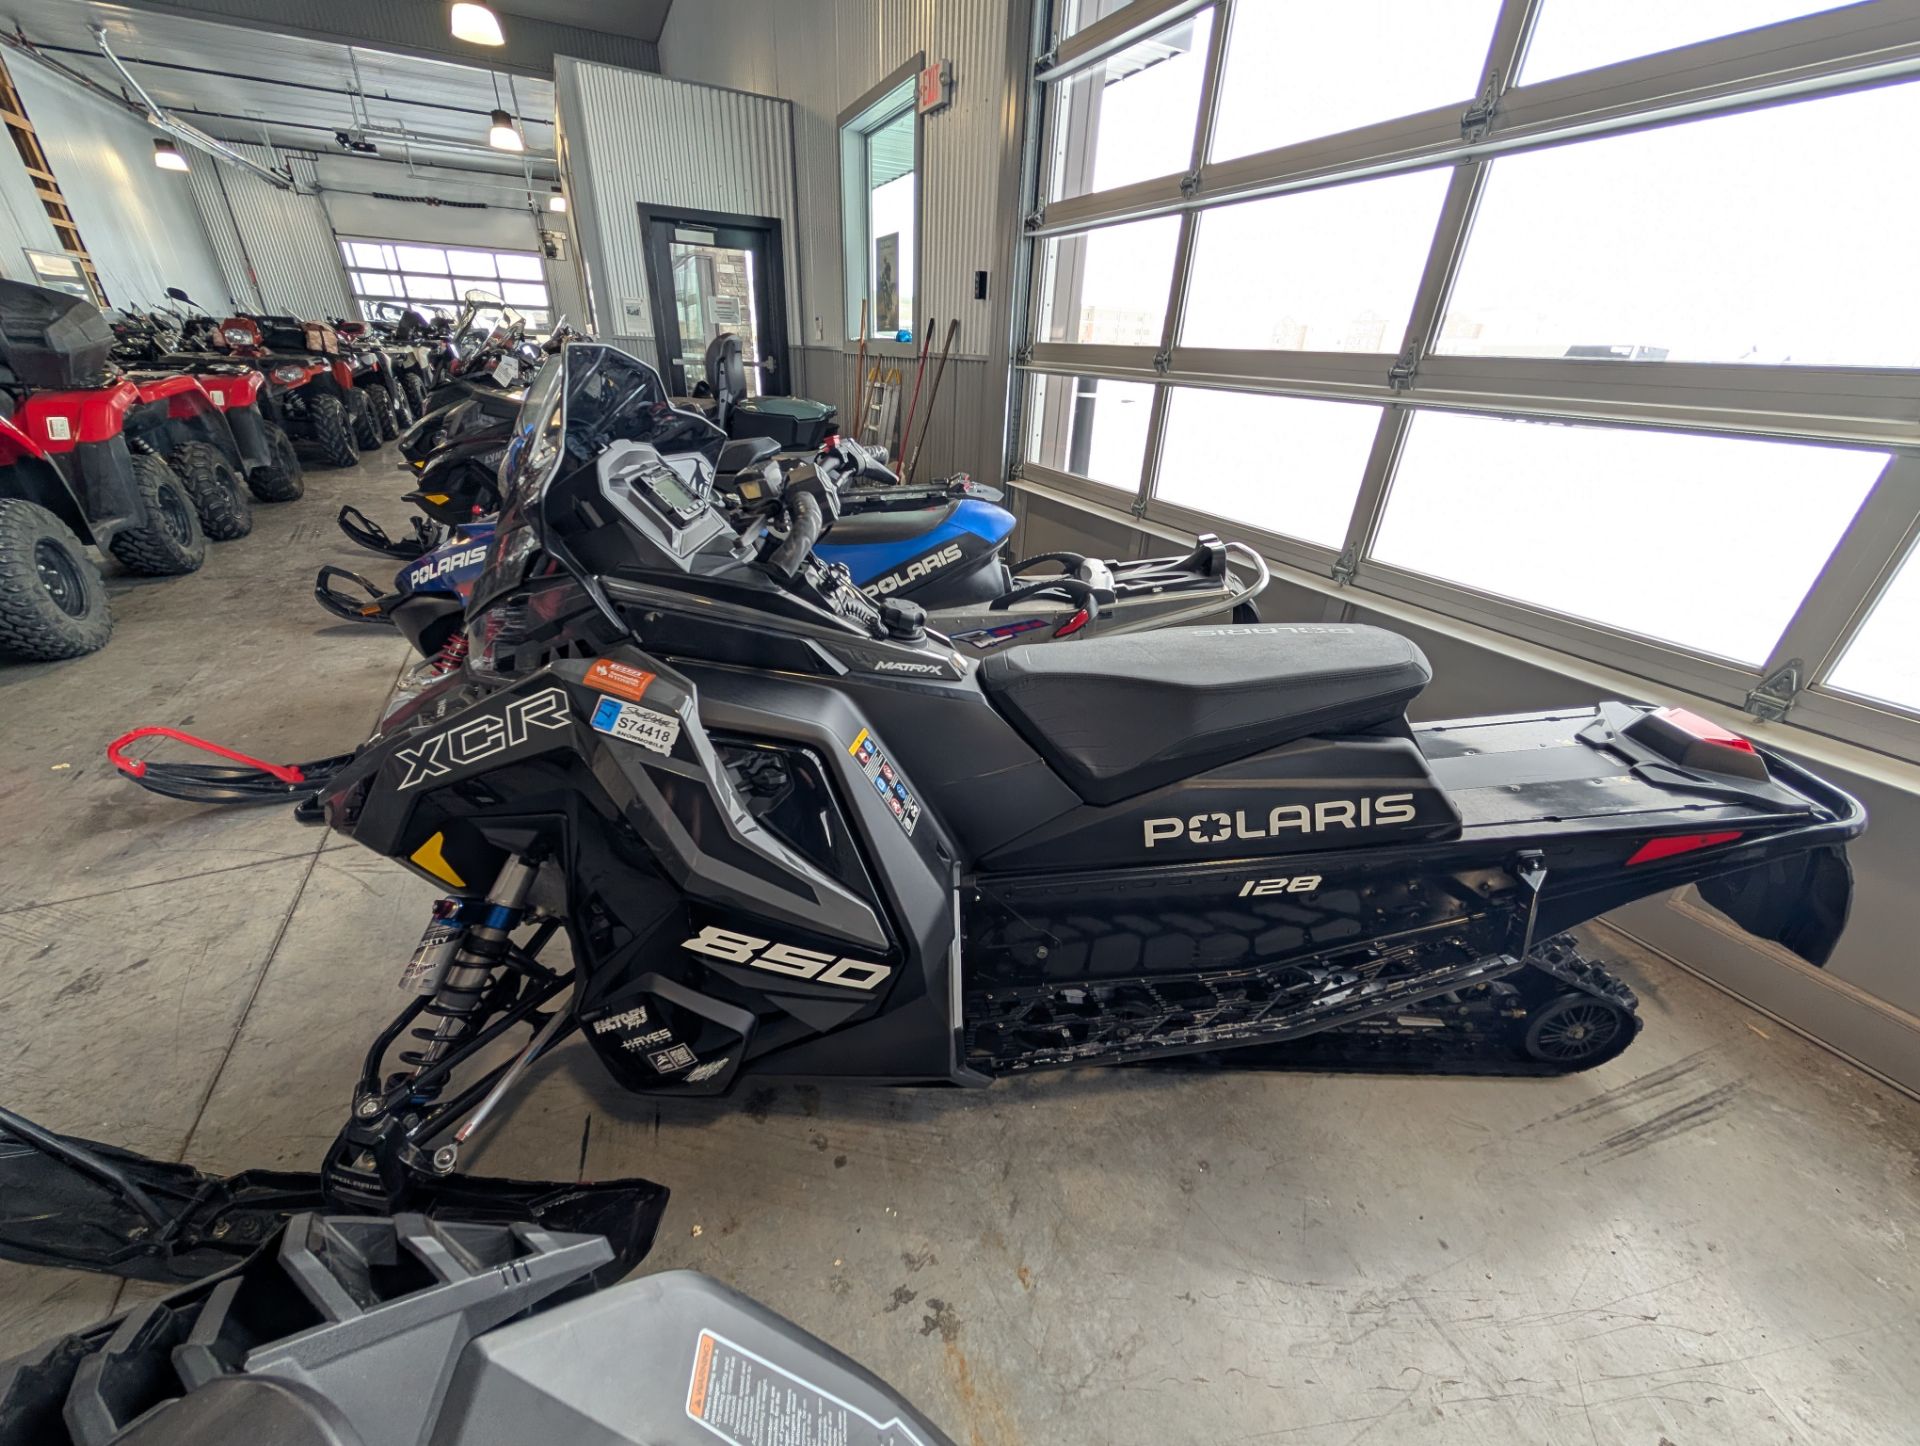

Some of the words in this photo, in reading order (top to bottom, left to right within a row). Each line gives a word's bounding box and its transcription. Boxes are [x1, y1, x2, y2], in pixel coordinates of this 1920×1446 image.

[923, 63, 940, 106] EXIT
[411, 545, 488, 590] POLARIS
[863, 543, 963, 597] POLARIS
[1191, 626, 1356, 638] POLARIS
[874, 660, 943, 676] MATRYX
[394, 686, 573, 791] XCR
[616, 730, 665, 749] SNOWMOBILE
[617, 716, 671, 742] S74418
[1143, 793, 1417, 848] POLARIS
[1238, 874, 1323, 897] 128
[680, 925, 892, 990] 850
[620, 1028, 672, 1050] HAYES
[698, 1343, 711, 1396] WARNING
